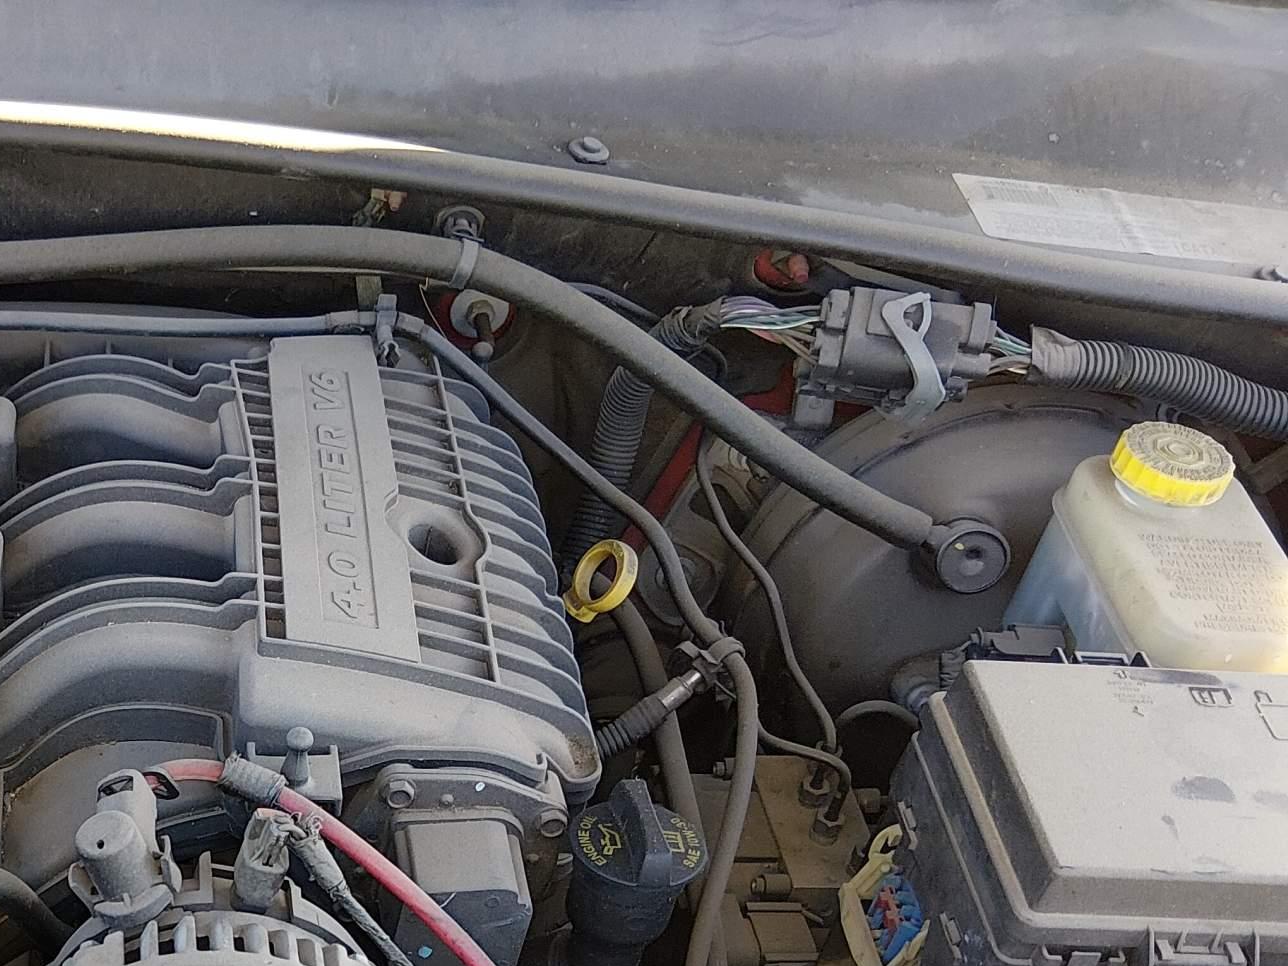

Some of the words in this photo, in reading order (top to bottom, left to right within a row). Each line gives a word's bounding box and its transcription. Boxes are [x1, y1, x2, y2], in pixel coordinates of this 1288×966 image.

[310, 369, 346, 412] V6
[317, 424, 358, 538] LITER
[579, 815, 599, 831] OIL
[577, 829, 608, 867] ENGINE
[682, 848, 701, 869] SAE
